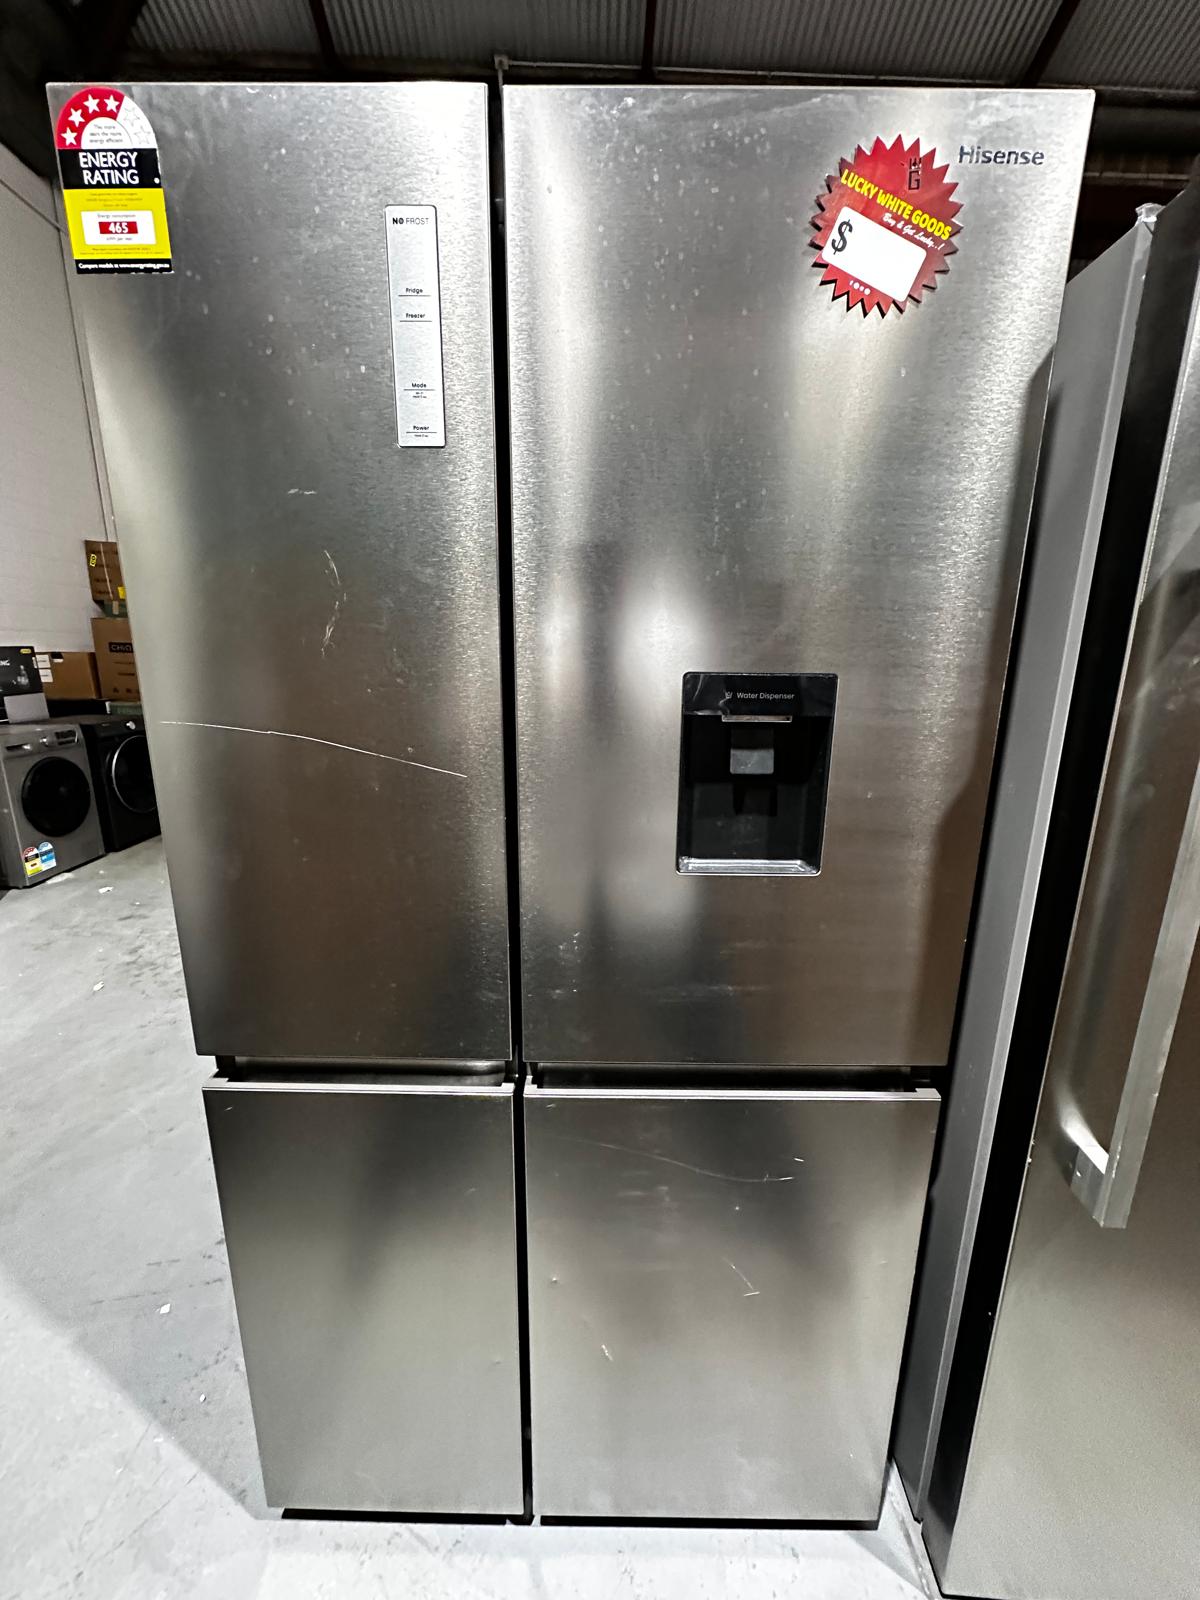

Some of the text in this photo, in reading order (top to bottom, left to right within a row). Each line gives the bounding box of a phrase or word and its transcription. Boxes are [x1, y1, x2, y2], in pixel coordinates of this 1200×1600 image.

[78, 151, 138, 168] ENERGY
[958, 144, 1045, 166] Hisense
[82, 169, 140, 185] RATING
[840, 168, 953, 241] LUCKY WHITE GOODS
[108, 222, 129, 233] 465
[405, 217, 429, 225] FROST
[882, 212, 896, 227] Buy
[902, 224, 917, 236] Get
[831, 219, 854, 255] $
[405, 287, 424, 295] Fridge
[736, 691, 796, 701] Water Dispenser
